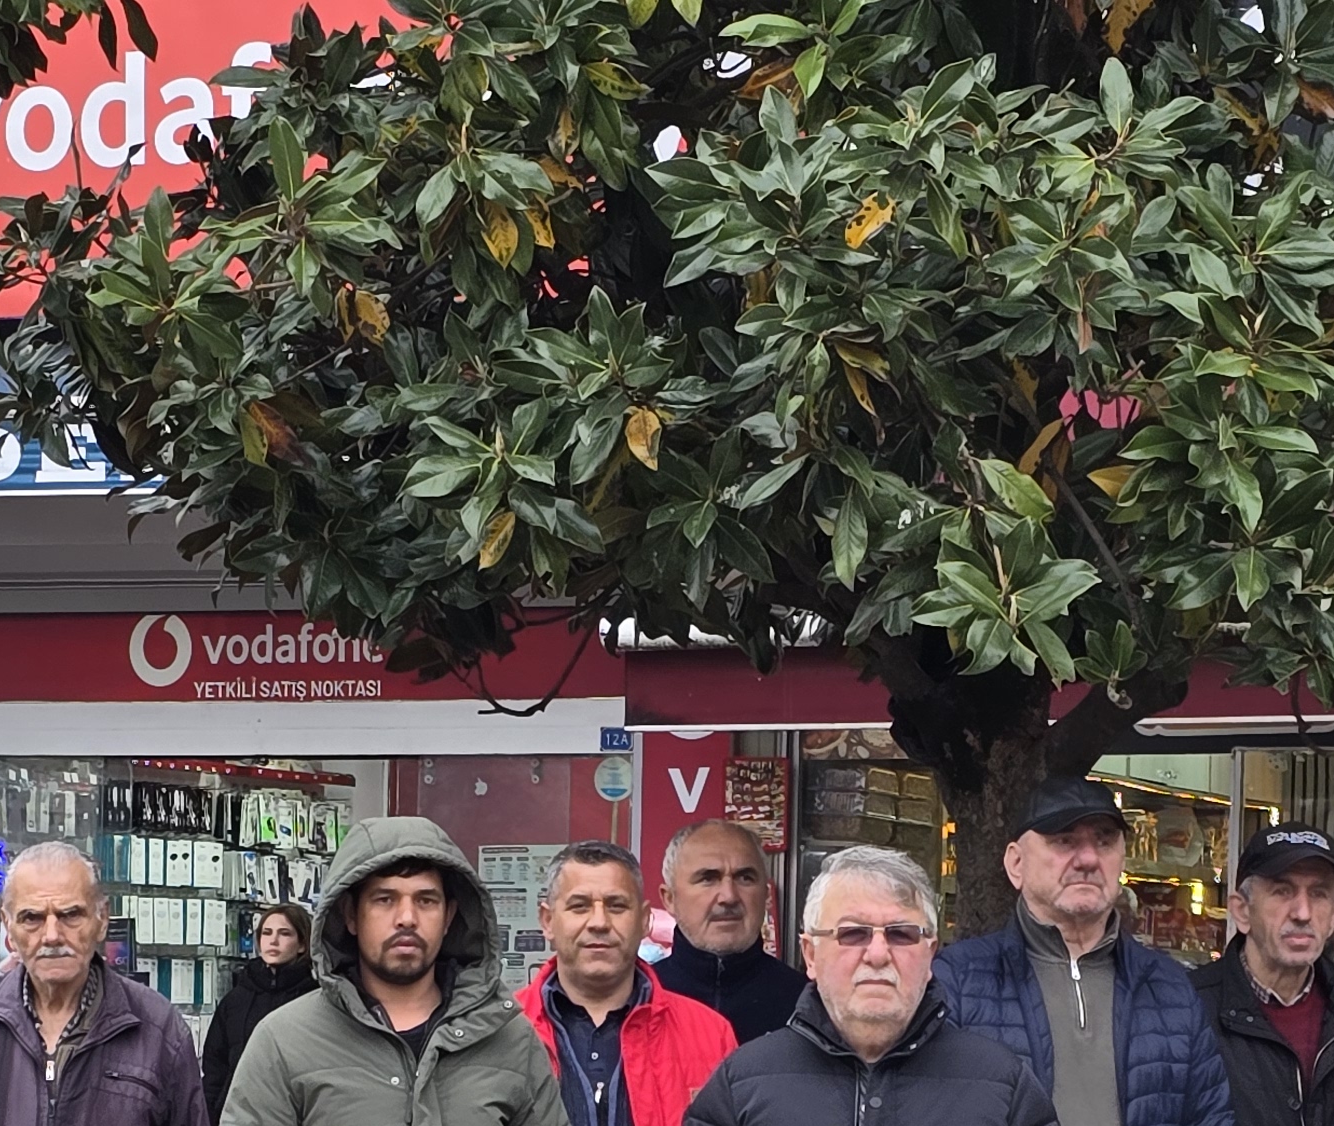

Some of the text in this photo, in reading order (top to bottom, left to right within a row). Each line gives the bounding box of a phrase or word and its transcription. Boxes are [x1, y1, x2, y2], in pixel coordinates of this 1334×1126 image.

[194, 677, 381, 700] YETKİLİ SATIŞ NOKTASI
[605, 734, 629, 747] 12A
